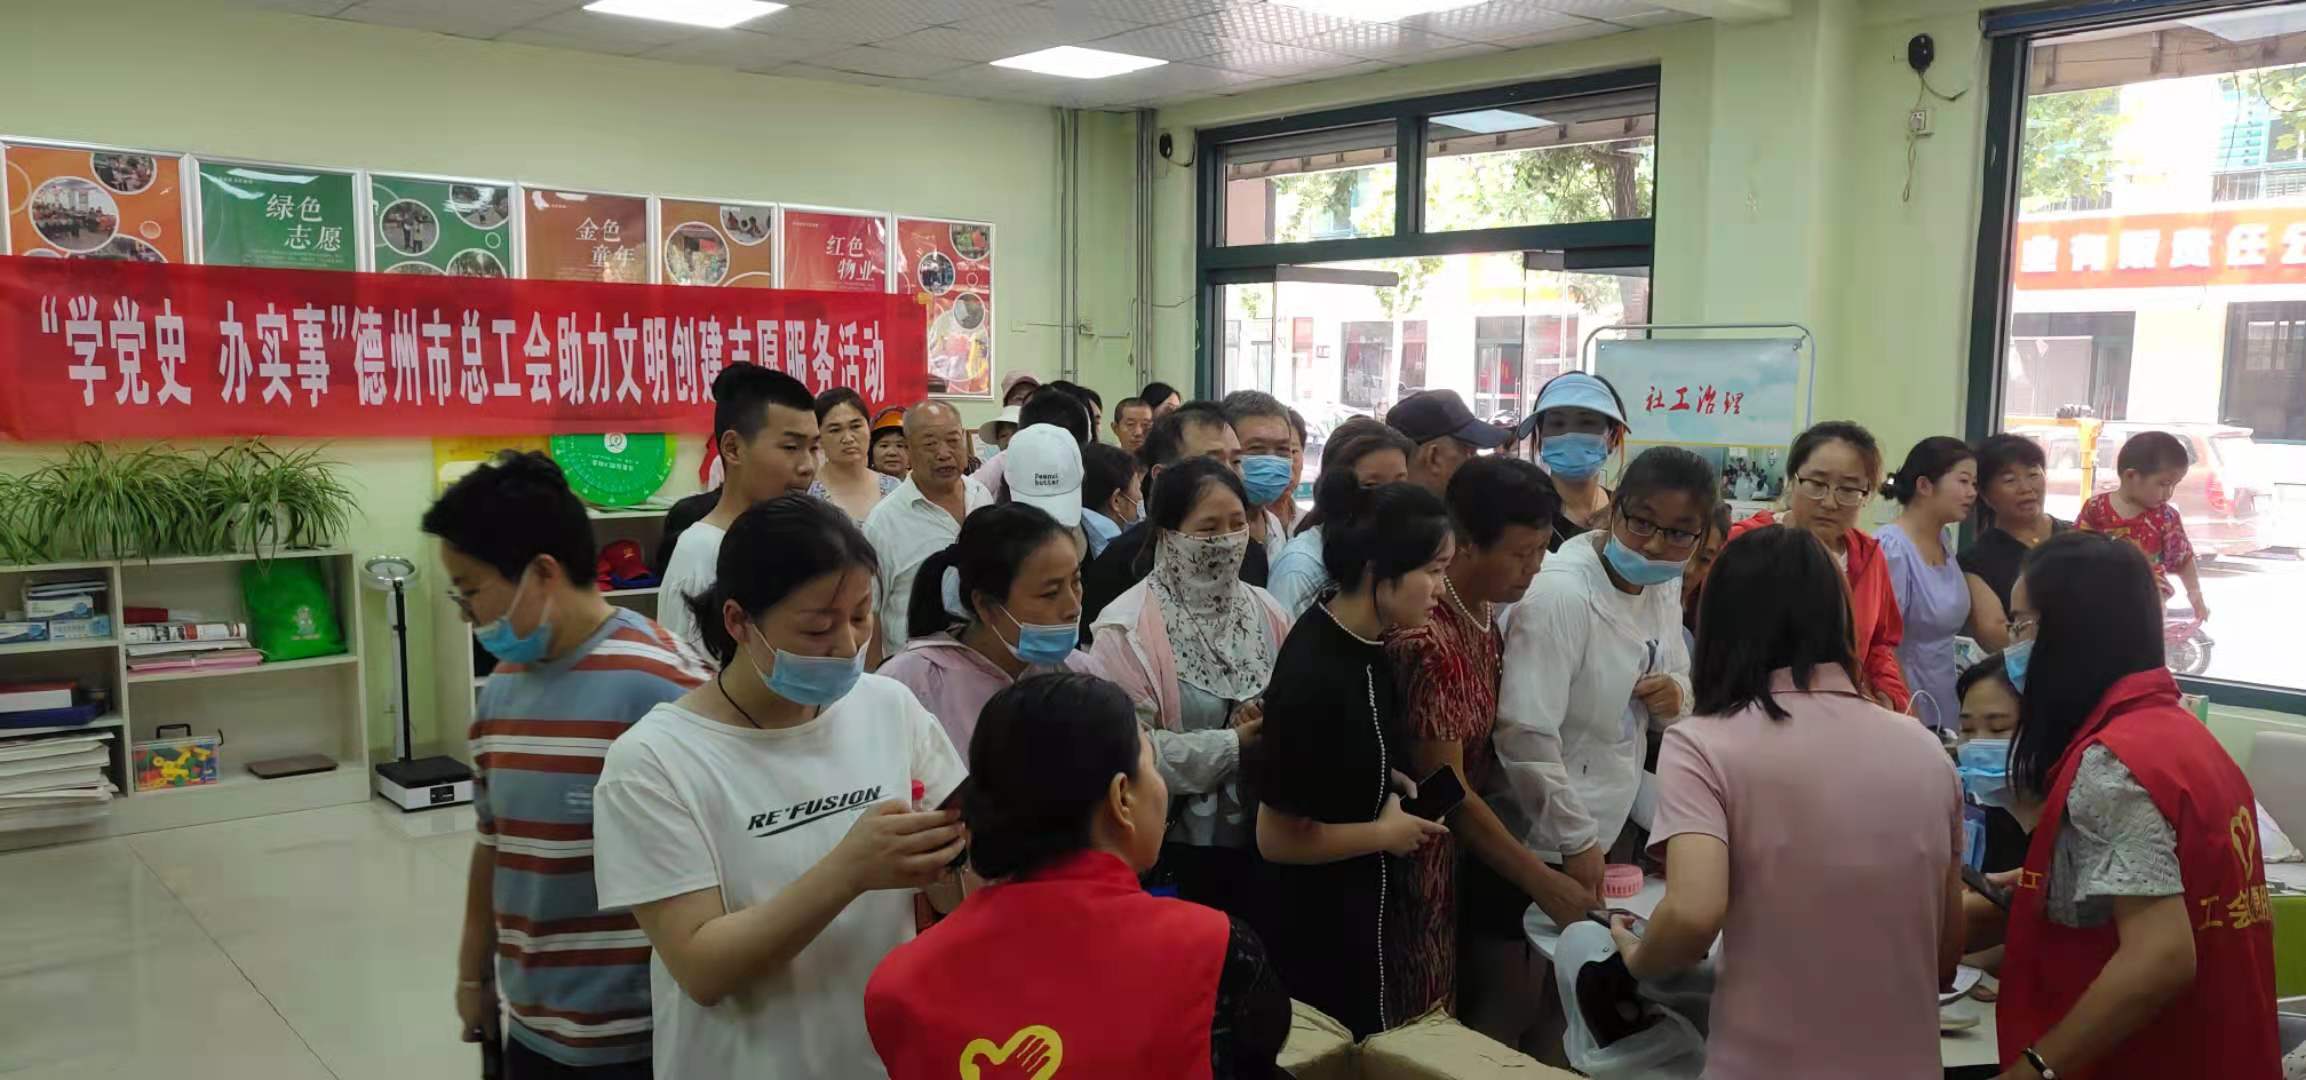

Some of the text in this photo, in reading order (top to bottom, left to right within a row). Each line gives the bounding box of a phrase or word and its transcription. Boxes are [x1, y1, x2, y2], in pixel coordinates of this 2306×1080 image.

[265, 193, 323, 222] 绿色
[284, 224, 343, 252] 志愿
[575, 216, 621, 242] 金色
[592, 243, 636, 268] 童年
[825, 234, 864, 258] 红色
[837, 258, 875, 281] 物业
[1644, 383, 1745, 415] 社工治理
